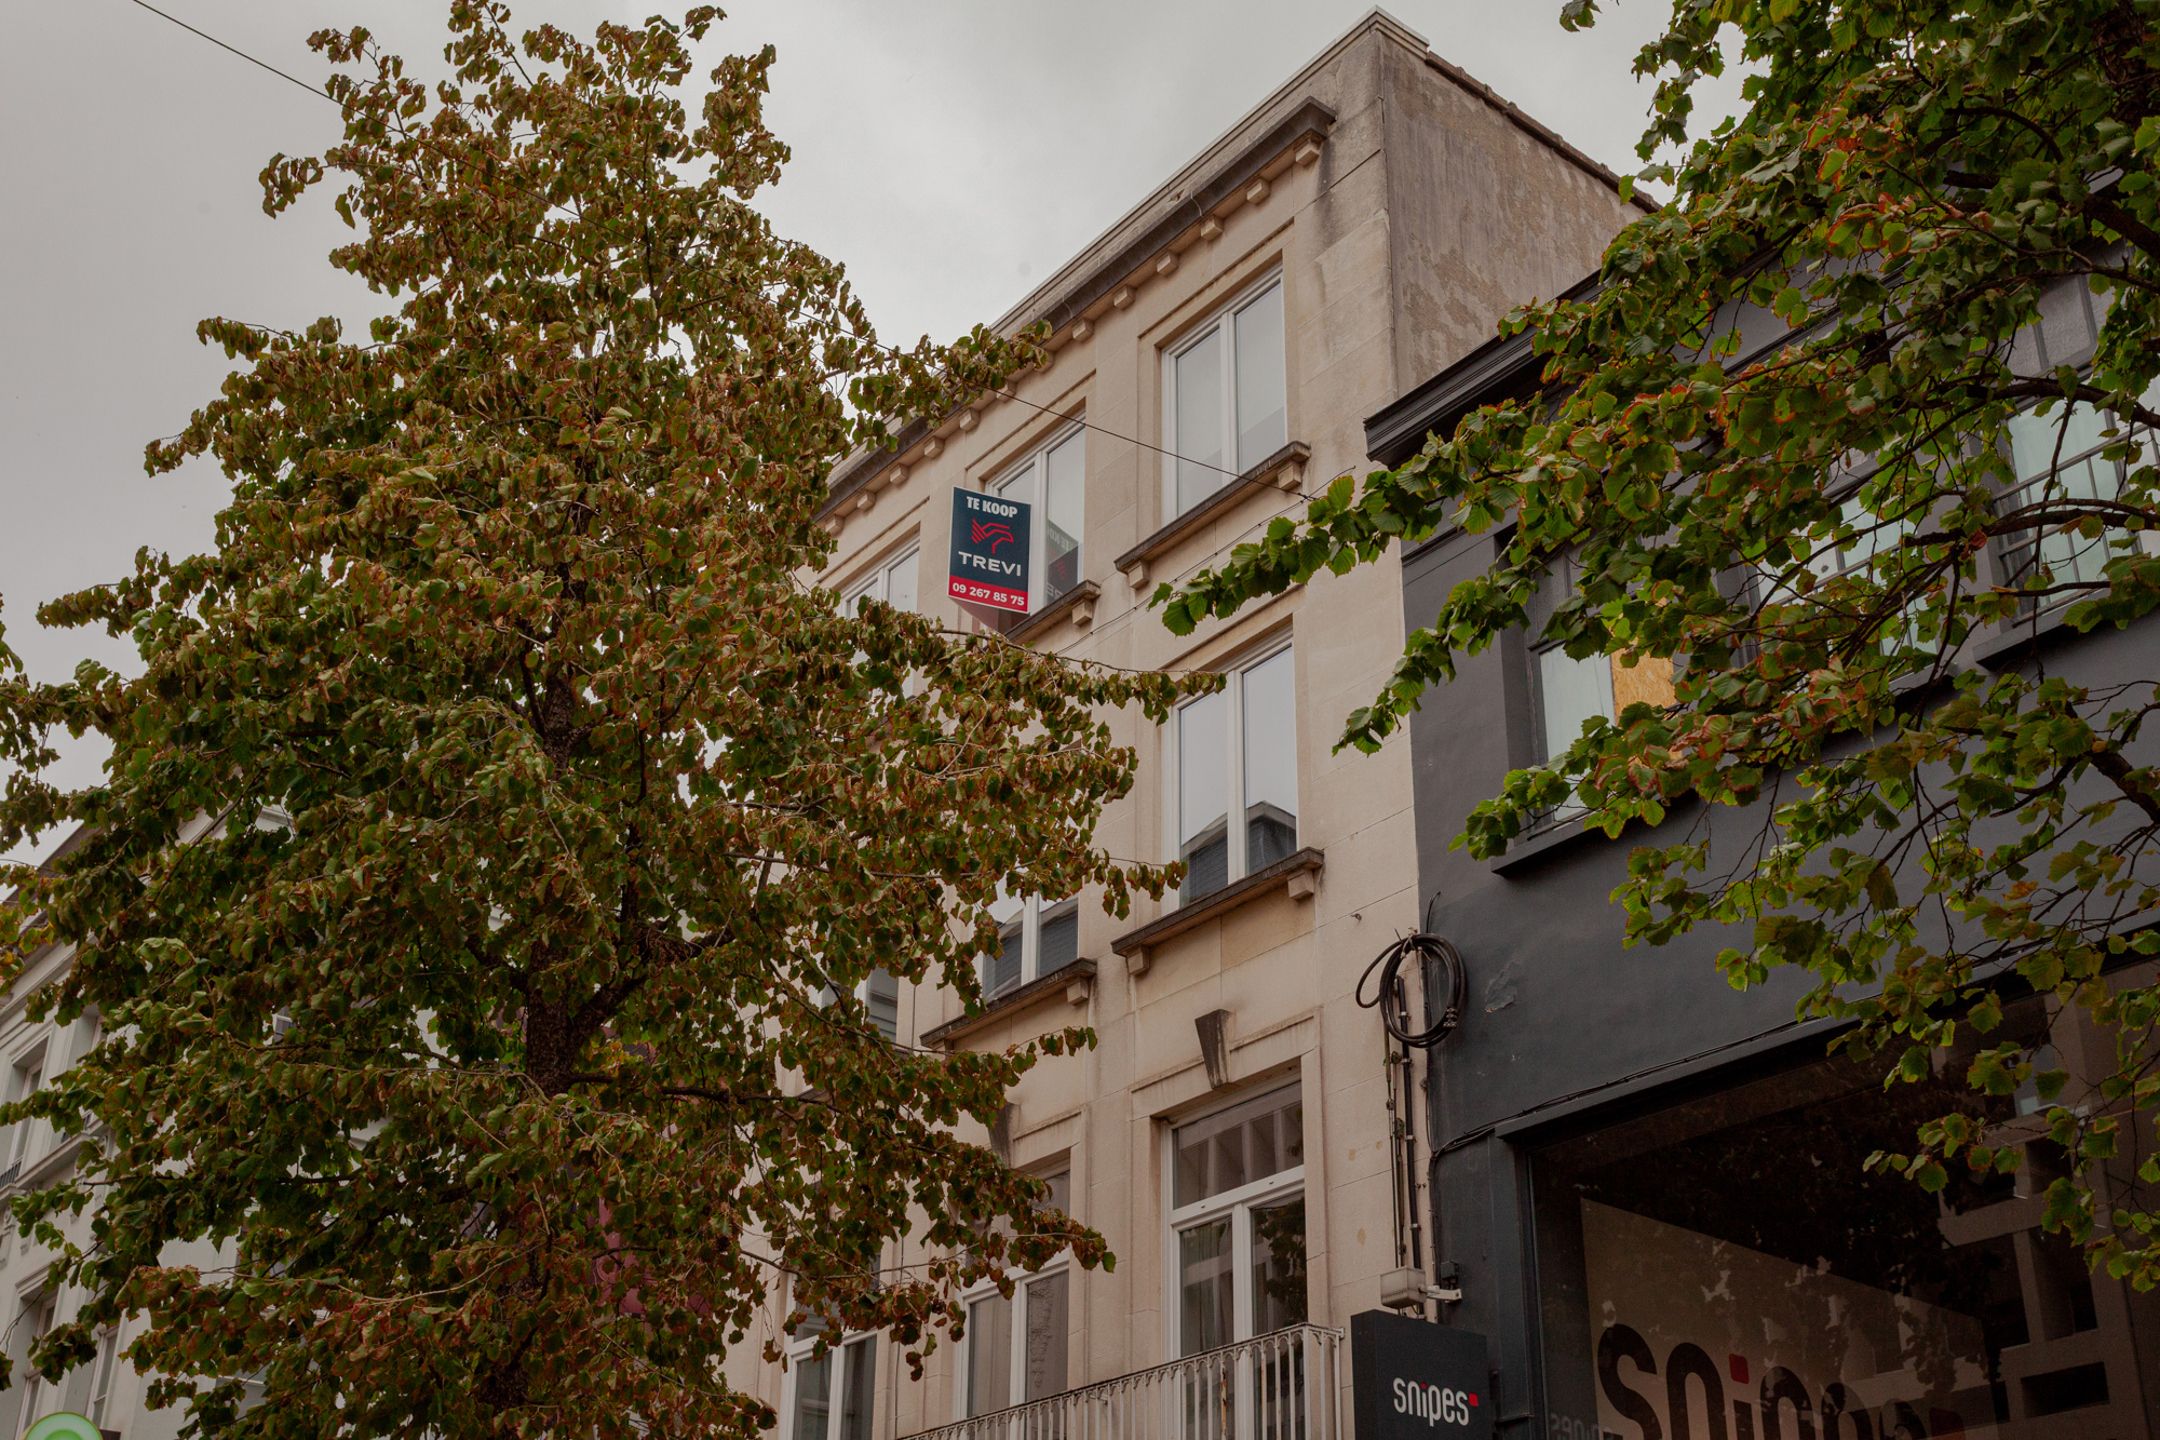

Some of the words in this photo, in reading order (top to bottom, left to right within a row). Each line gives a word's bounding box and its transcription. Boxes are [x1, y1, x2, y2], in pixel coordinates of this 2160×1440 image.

[966, 496, 981, 511] TE
[982, 499, 1018, 518] KOOP
[958, 551, 1022, 576] TREVI
[952, 582, 967, 594] 09
[969, 585, 991, 599] 267
[993, 590, 1008, 604] 85
[1010, 594, 1025, 606] 75
[1393, 1377, 1470, 1427] snipes
